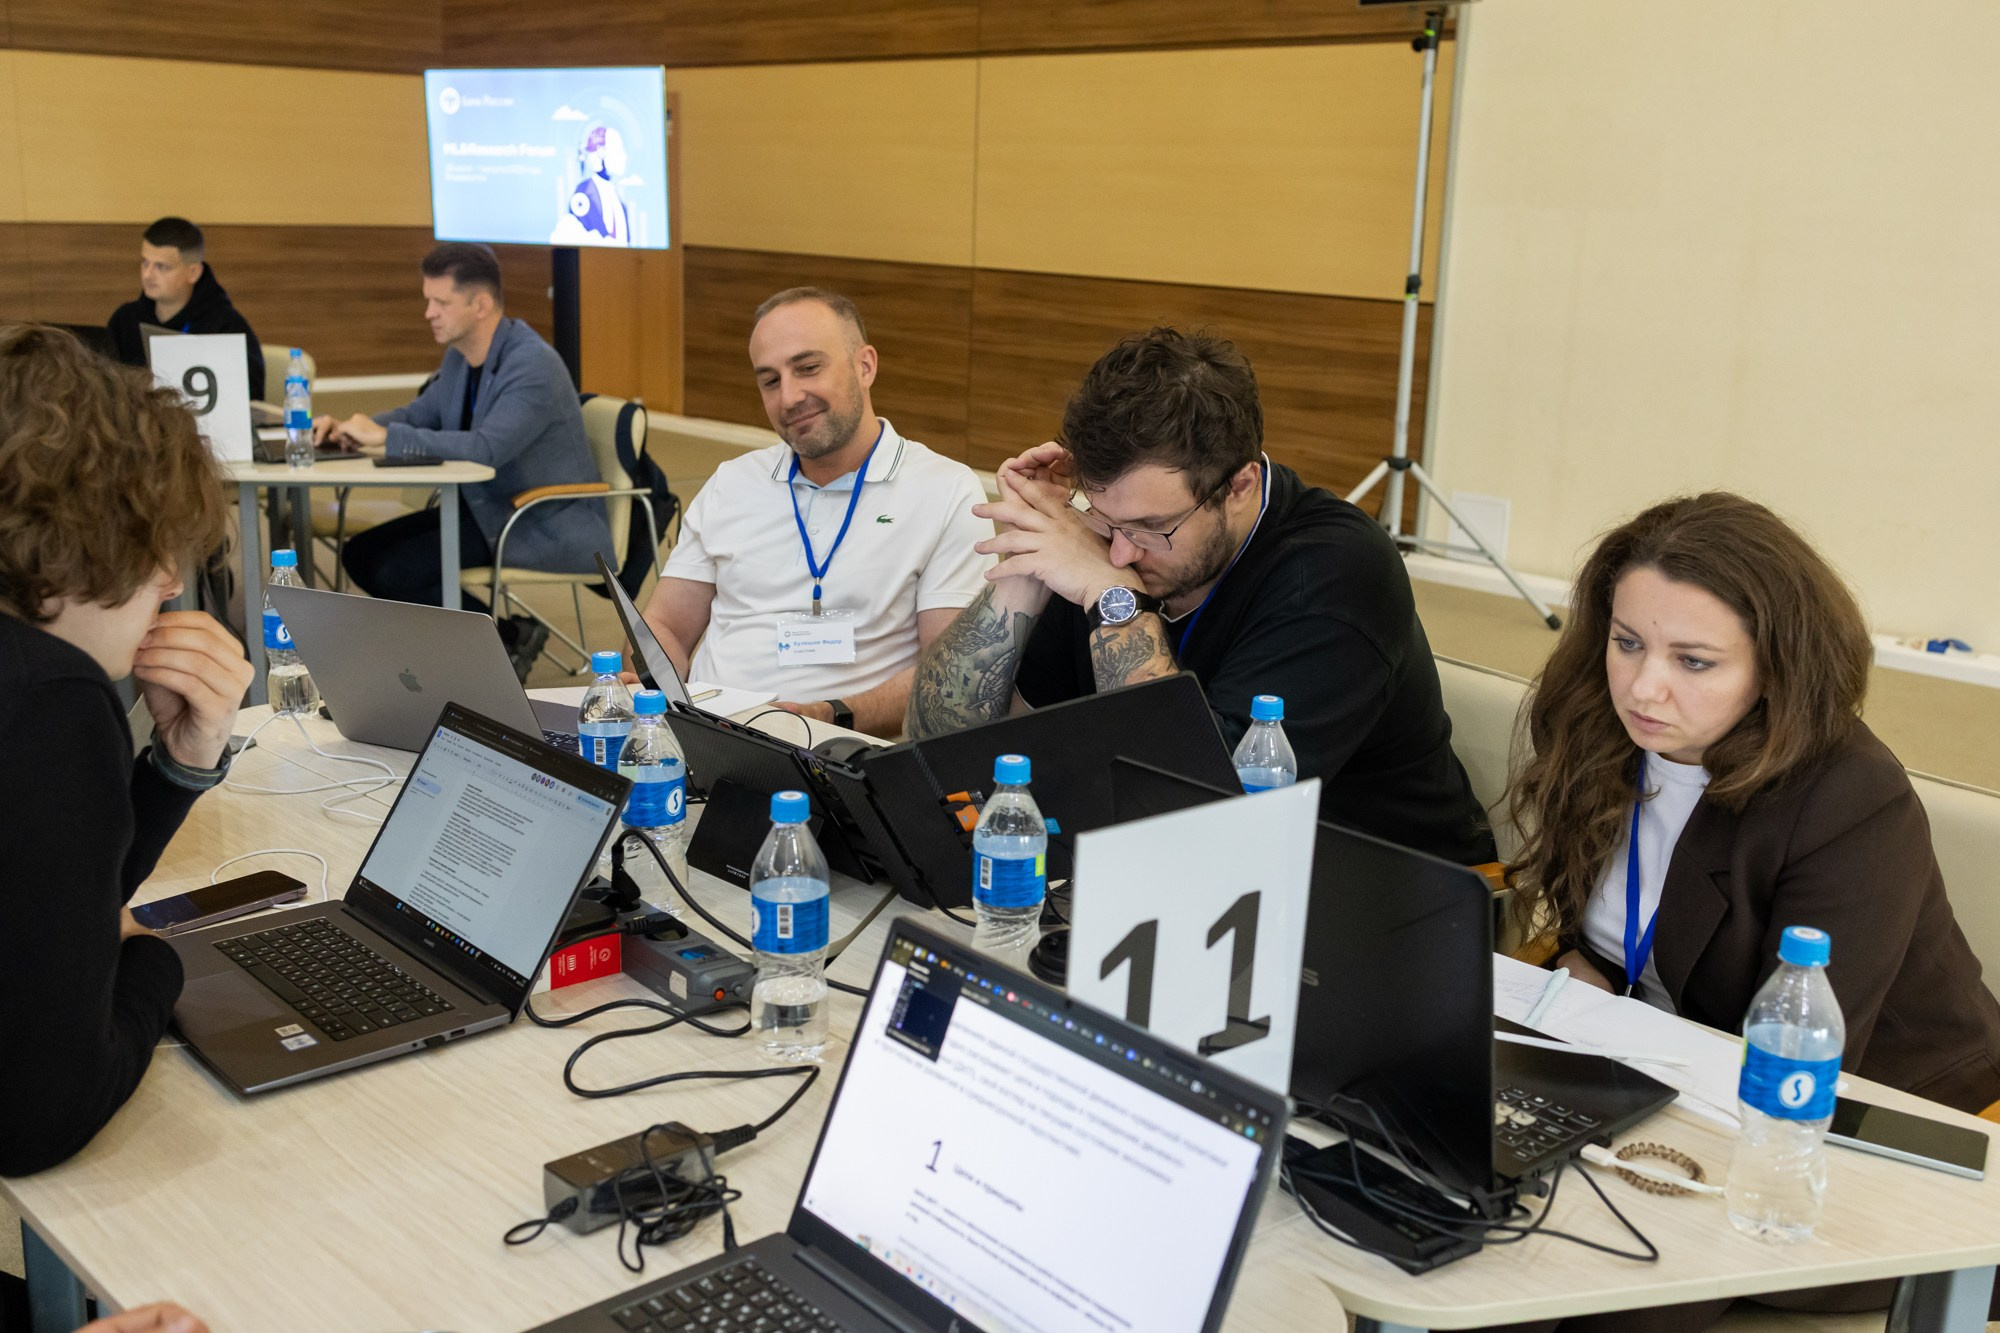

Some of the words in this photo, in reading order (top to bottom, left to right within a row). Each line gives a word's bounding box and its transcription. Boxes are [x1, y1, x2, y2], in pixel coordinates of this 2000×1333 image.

[182, 366, 218, 417] 9
[1100, 890, 1271, 1057] 11
[925, 1140, 942, 1173] 1
